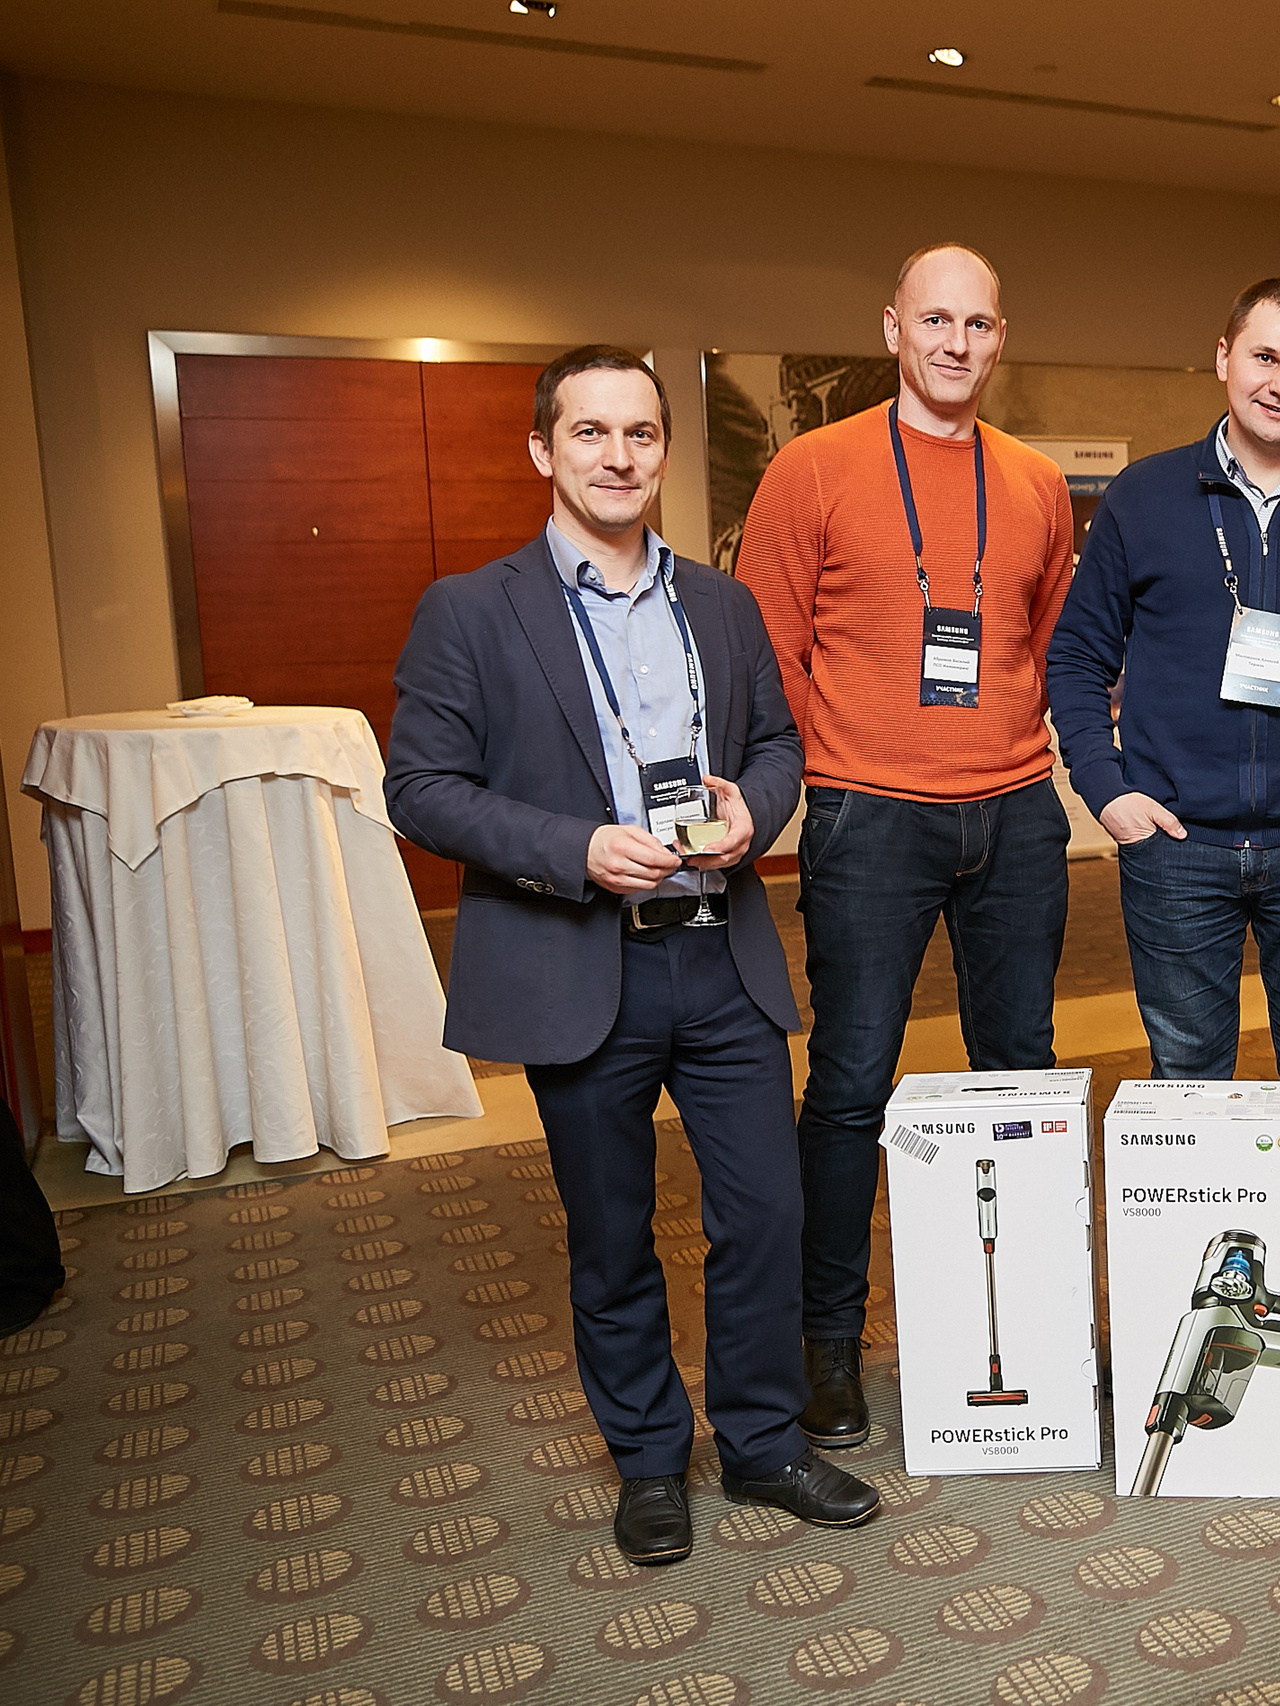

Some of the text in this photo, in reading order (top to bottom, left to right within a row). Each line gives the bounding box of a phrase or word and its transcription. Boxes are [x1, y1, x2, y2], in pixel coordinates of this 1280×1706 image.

[1246, 626, 1280, 638] SAMSUNG
[653, 778, 687, 791] SAMSUNG
[1120, 1134, 1196, 1146] SAMSUNG
[1122, 1187, 1267, 1203] POWERstick Pro
[1122, 1207, 1162, 1217] VS8000
[931, 1426, 1069, 1443] POWERstick Pro
[982, 1446, 1019, 1455] VS8000
